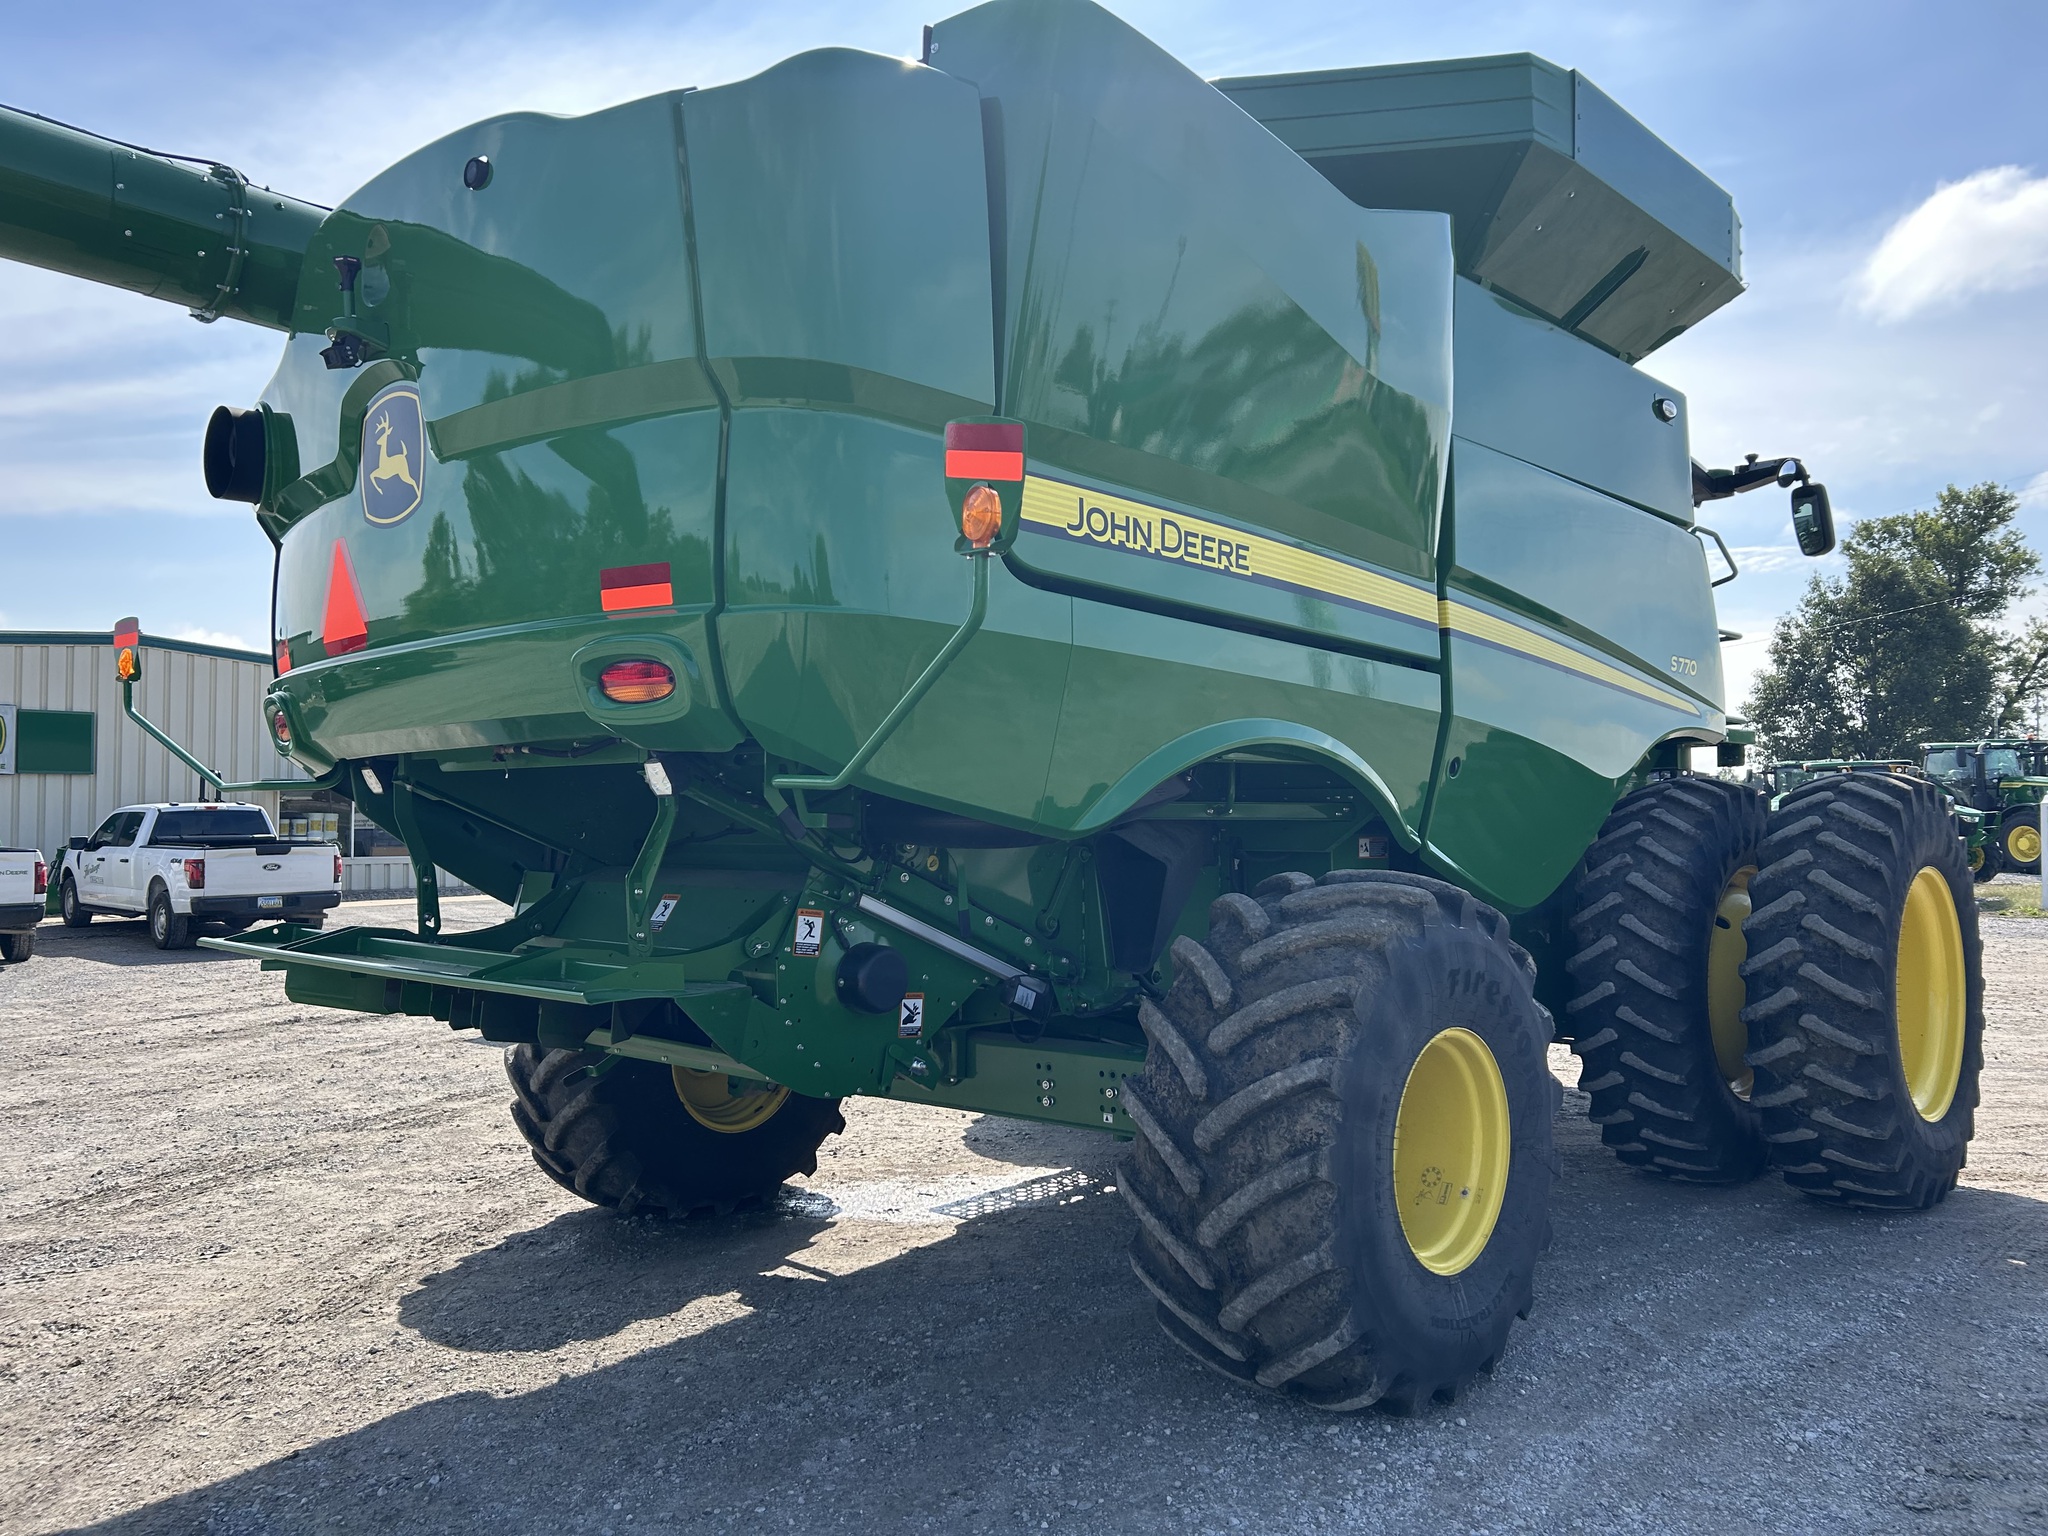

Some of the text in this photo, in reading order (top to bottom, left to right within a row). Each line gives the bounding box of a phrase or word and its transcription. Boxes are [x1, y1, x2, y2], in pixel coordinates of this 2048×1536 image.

[1066, 497, 1251, 572] JOHN DEERE
[1671, 655, 1697, 676] S770
